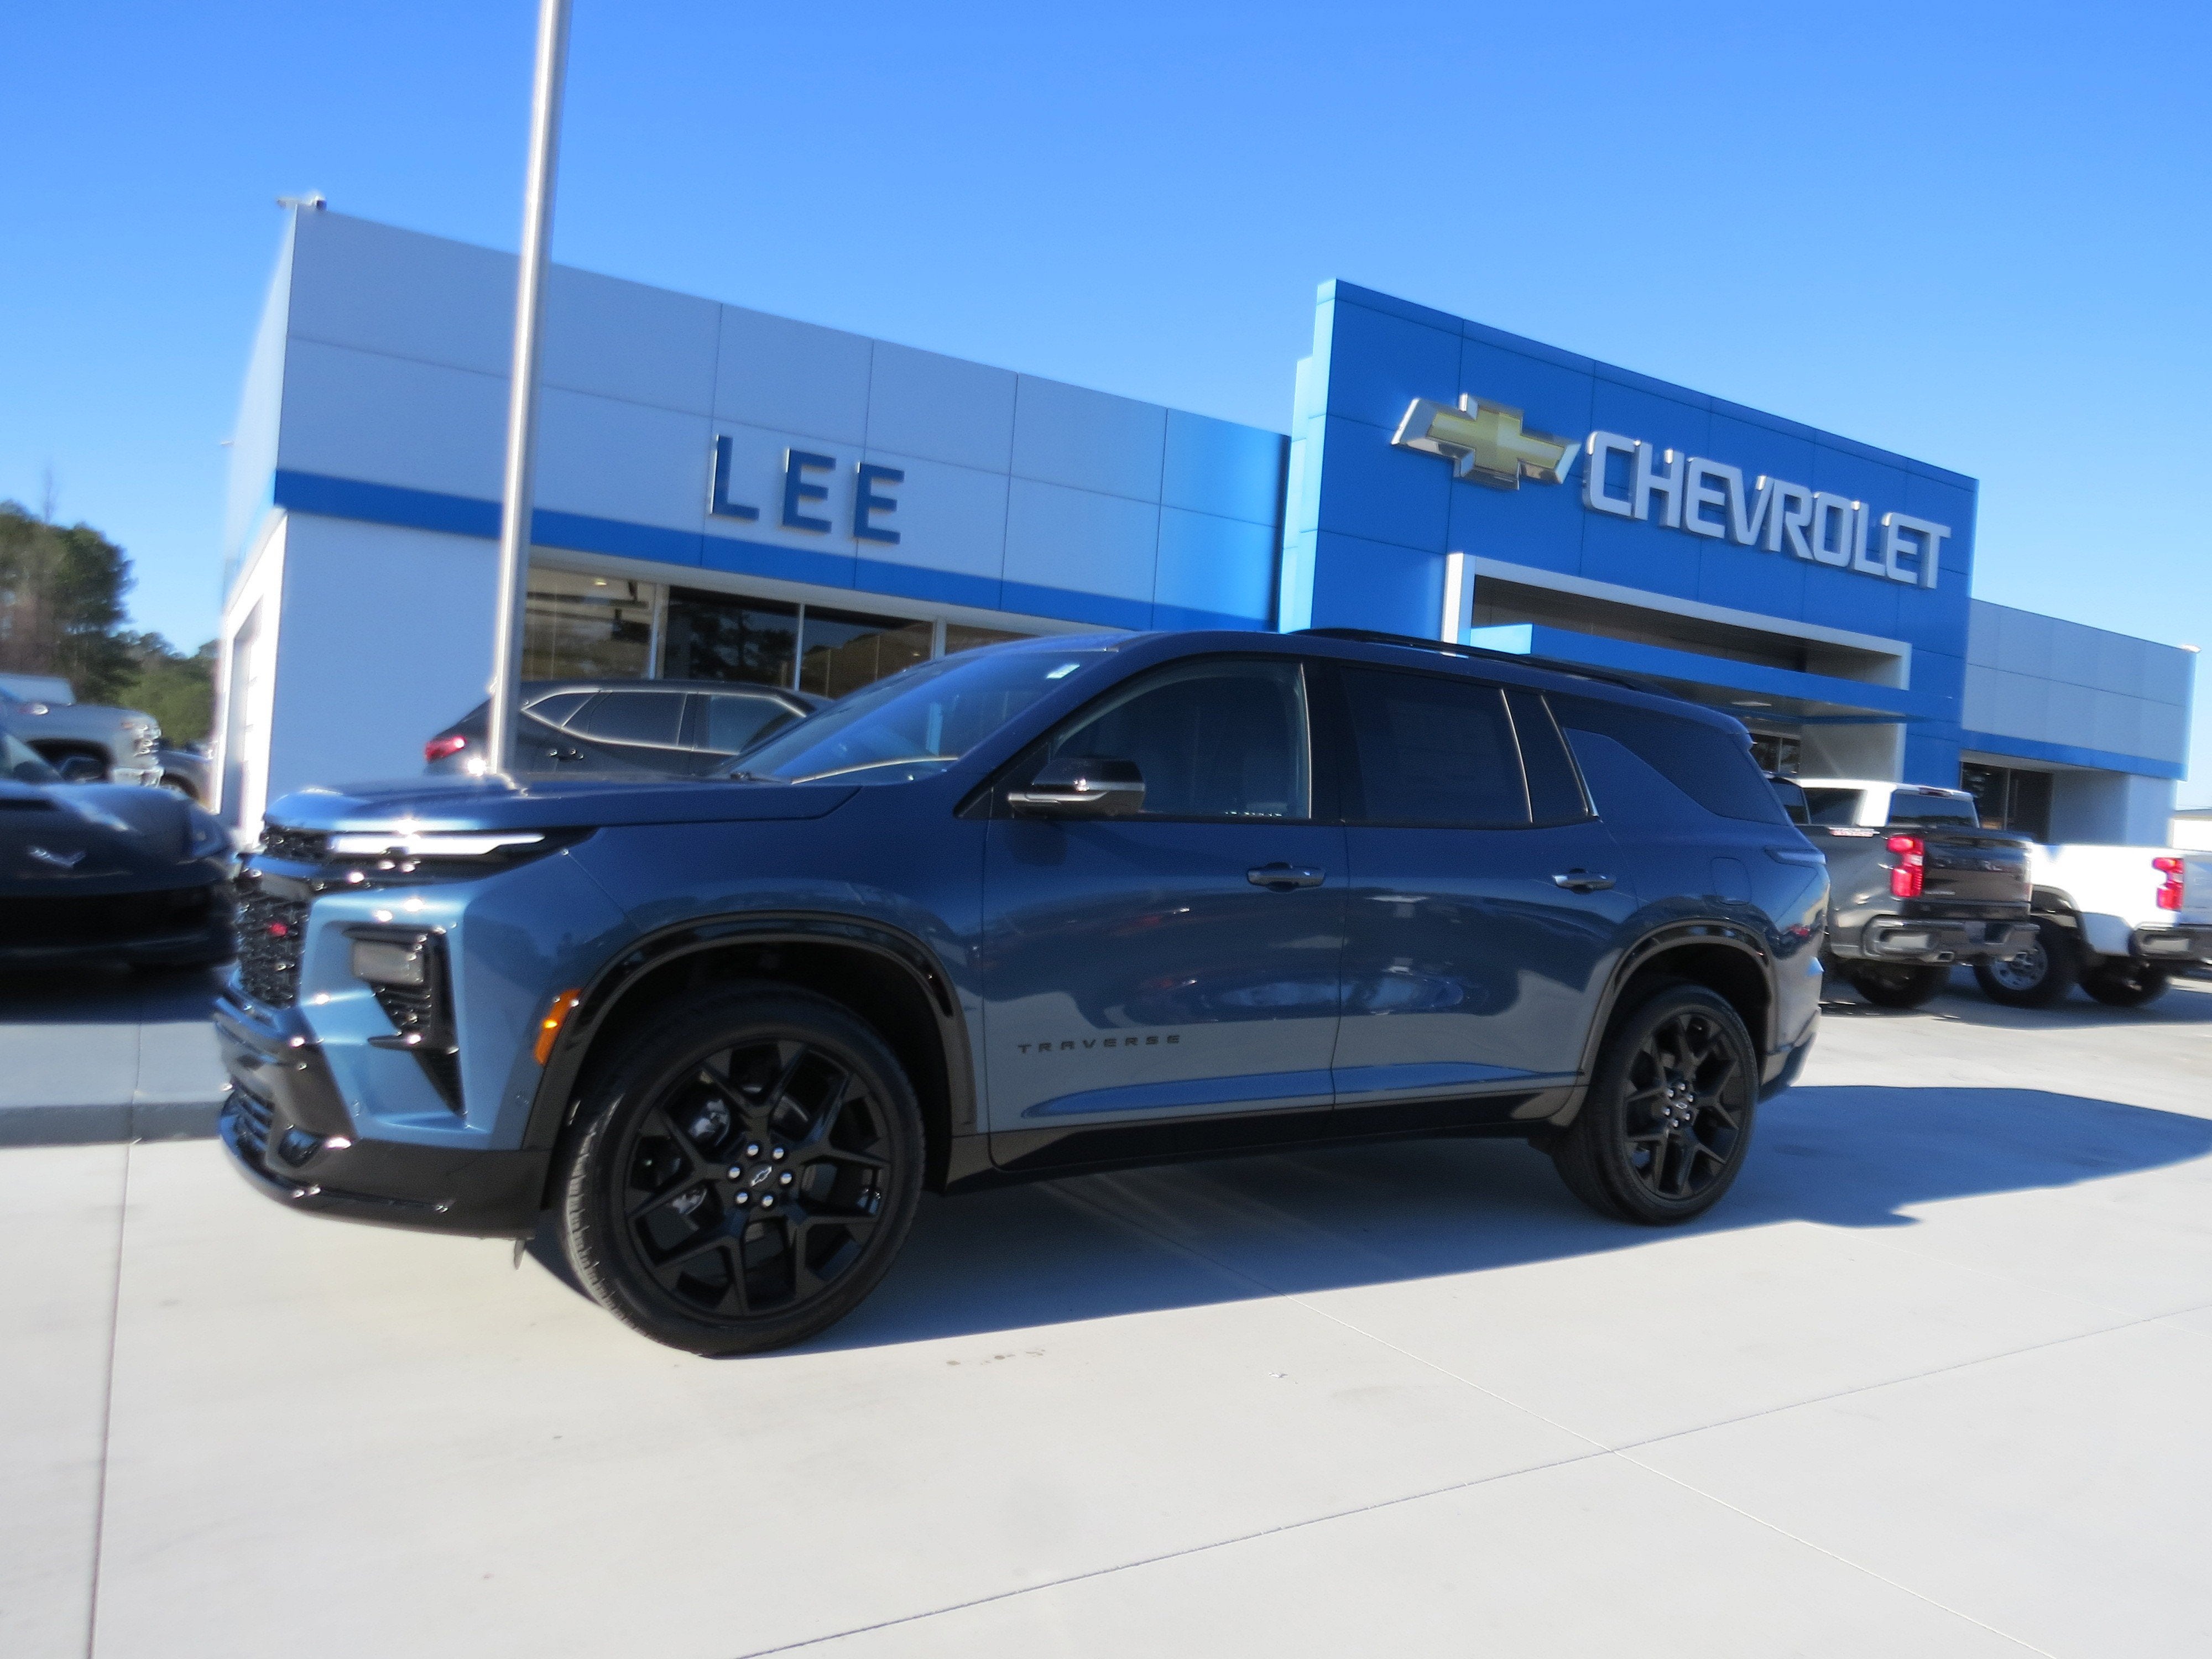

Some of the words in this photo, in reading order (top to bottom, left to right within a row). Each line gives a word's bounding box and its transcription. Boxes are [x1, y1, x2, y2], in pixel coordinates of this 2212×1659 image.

[710, 435, 905, 545] LEE
[1584, 431, 1951, 589] CHEVROLET
[1018, 1035, 1180, 1053] TRAVERSE
